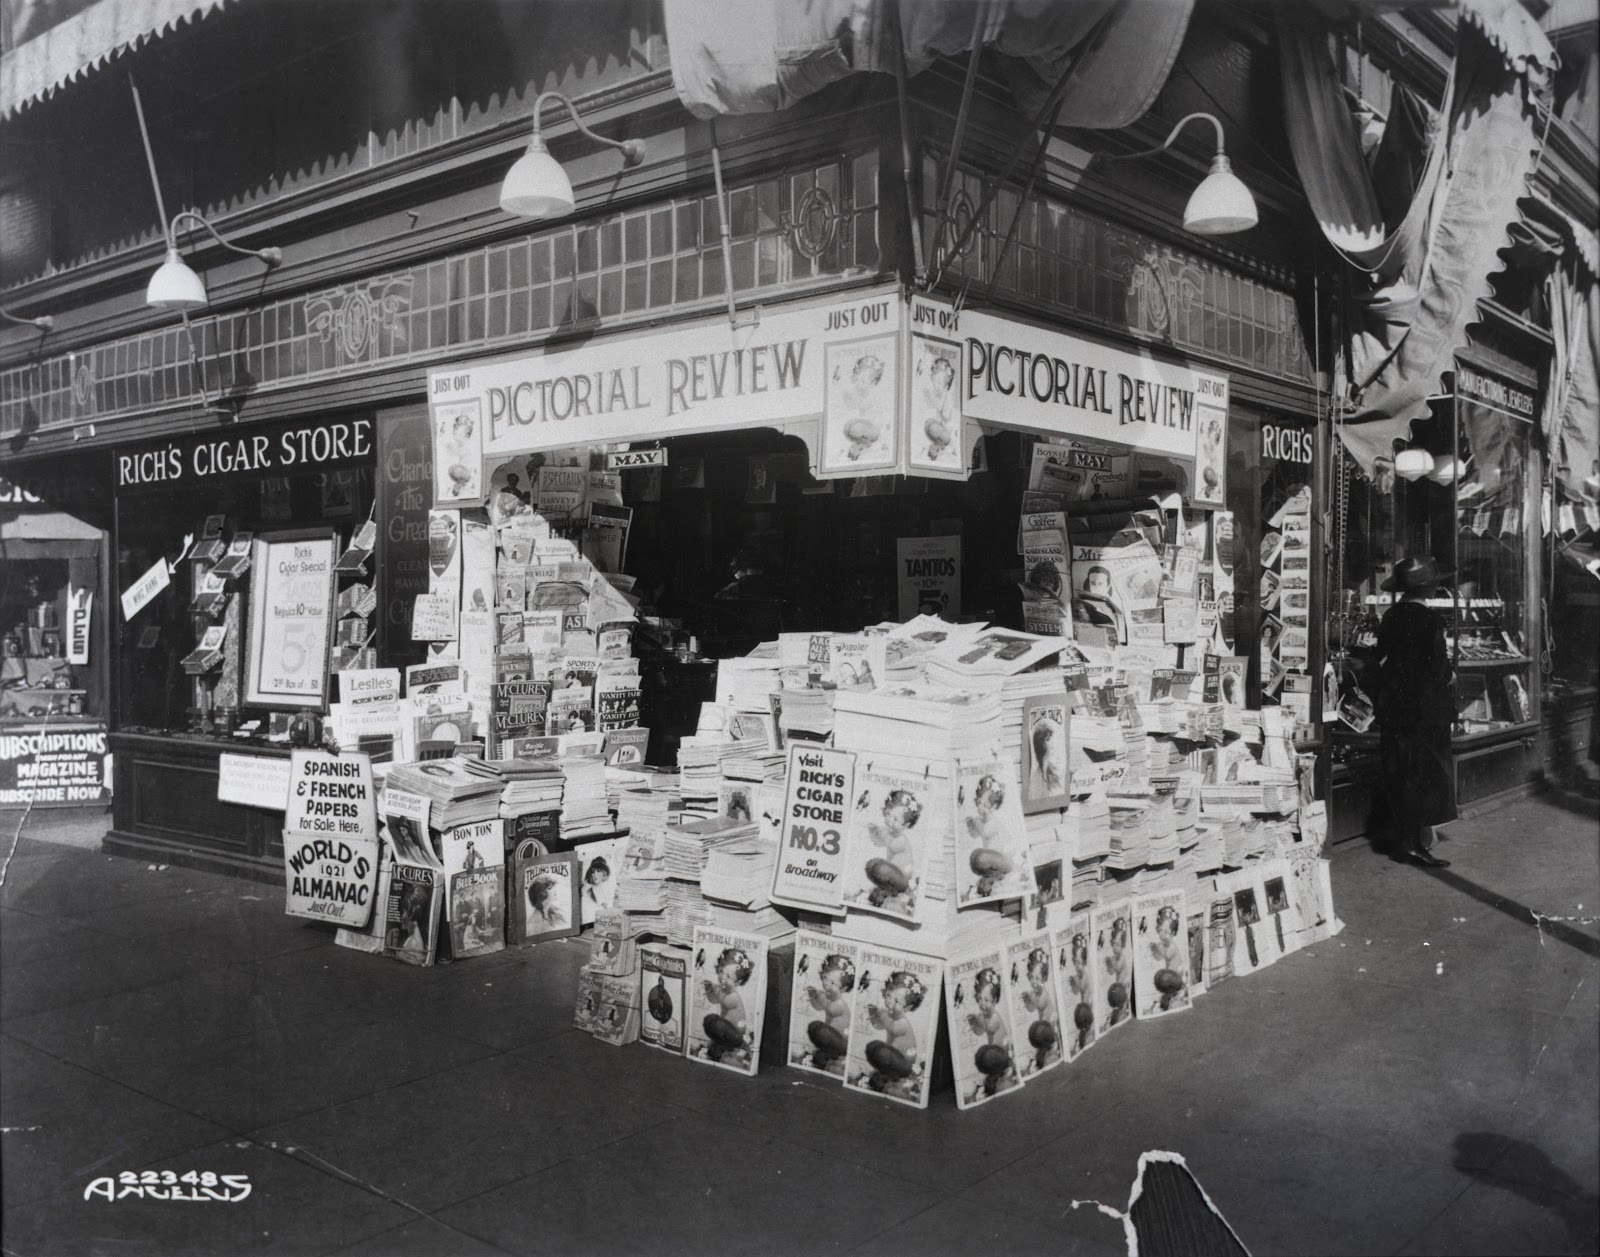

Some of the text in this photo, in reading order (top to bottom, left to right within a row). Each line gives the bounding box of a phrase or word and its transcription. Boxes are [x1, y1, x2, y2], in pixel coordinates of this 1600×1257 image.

[824, 302, 890, 331] JUST OUT
[913, 303, 959, 332] JUST OUT
[433, 374, 471, 394] JUST OUT
[485, 339, 808, 441] PICTORIAL REVIEW
[966, 337, 1194, 431] PICTORIAL REVIEW
[1197, 374, 1225, 398] JUST OUT
[1460, 370, 1533, 415] MANUFACTURING JEWELERS
[119, 419, 372, 486] RICH'S CIGAR STORE
[1262, 424, 1313, 464] RICH'S
[387, 449, 432, 484] Charle
[614, 452, 658, 467] MAY
[1075, 453, 1106, 468] MAY
[388, 514, 429, 543] Grea
[1028, 515, 1057, 528] Golfer
[1079, 548, 1104, 560] Mir
[279, 561, 326, 577] Cigar Special
[905, 558, 956, 578] TANTOS
[1027, 622, 1061, 633] SYSTEM
[566, 660, 596, 668] SPORTS
[350, 678, 393, 691] Leslie's
[373, 694, 394, 702] WORLD
[17, 761, 99, 779] MAGAZINE
[304, 760, 361, 778] SPANISH
[798, 753, 824, 768] Visit
[799, 769, 845, 788] RICH'S
[67, 785, 102, 801] NOW
[311, 781, 367, 800] FRENCH
[796, 786, 844, 806] CIGAR
[306, 799, 359, 818] PAPERS
[792, 803, 843, 824] STORE
[313, 818, 336, 832] Sale
[452, 823, 498, 841] BON TON
[289, 840, 371, 880] WORLD'S
[806, 858, 817, 868] on
[320, 864, 345, 878] 1921
[550, 863, 569, 878] TALES
[785, 863, 838, 884] Broadway
[456, 872, 498, 890] BLUE BOOK
[292, 876, 370, 907] ALMANAC
[308, 901, 326, 914] Just
[698, 932, 761, 951] PICTORIAL REVIEW
[800, 937, 858, 956] PICTORIAL REVIE
[863, 952, 932, 974] PICTORIAL REVIEW
